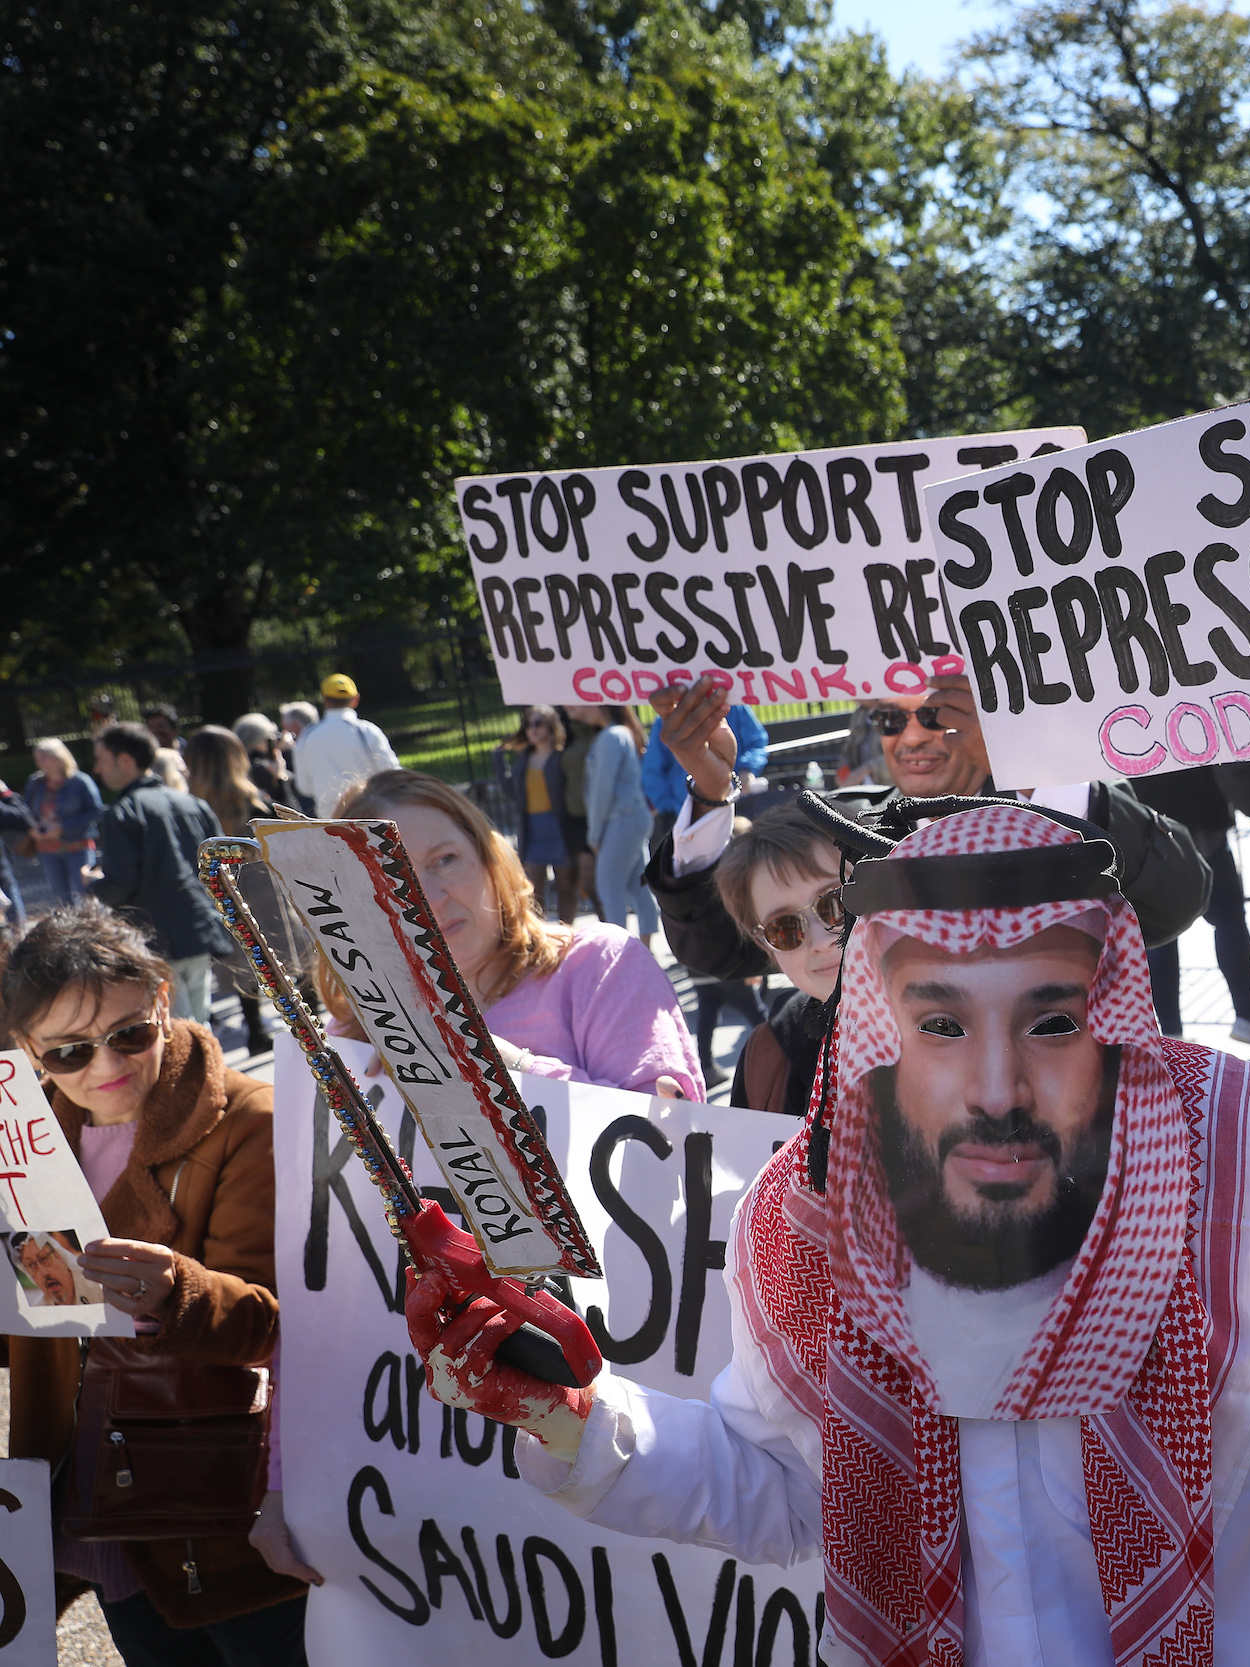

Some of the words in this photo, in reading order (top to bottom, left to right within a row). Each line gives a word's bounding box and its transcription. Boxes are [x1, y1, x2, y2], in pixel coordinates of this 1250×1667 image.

[462, 473, 596, 564] STOP
[617, 453, 930, 562] SUPPORT
[937, 447, 1134, 589] STOP
[481, 561, 849, 669] REPRESSIVE
[862, 558, 964, 665] RE
[440, 1125, 534, 1245] ROYAL
[346, 1466, 617, 1667] SAUDI
